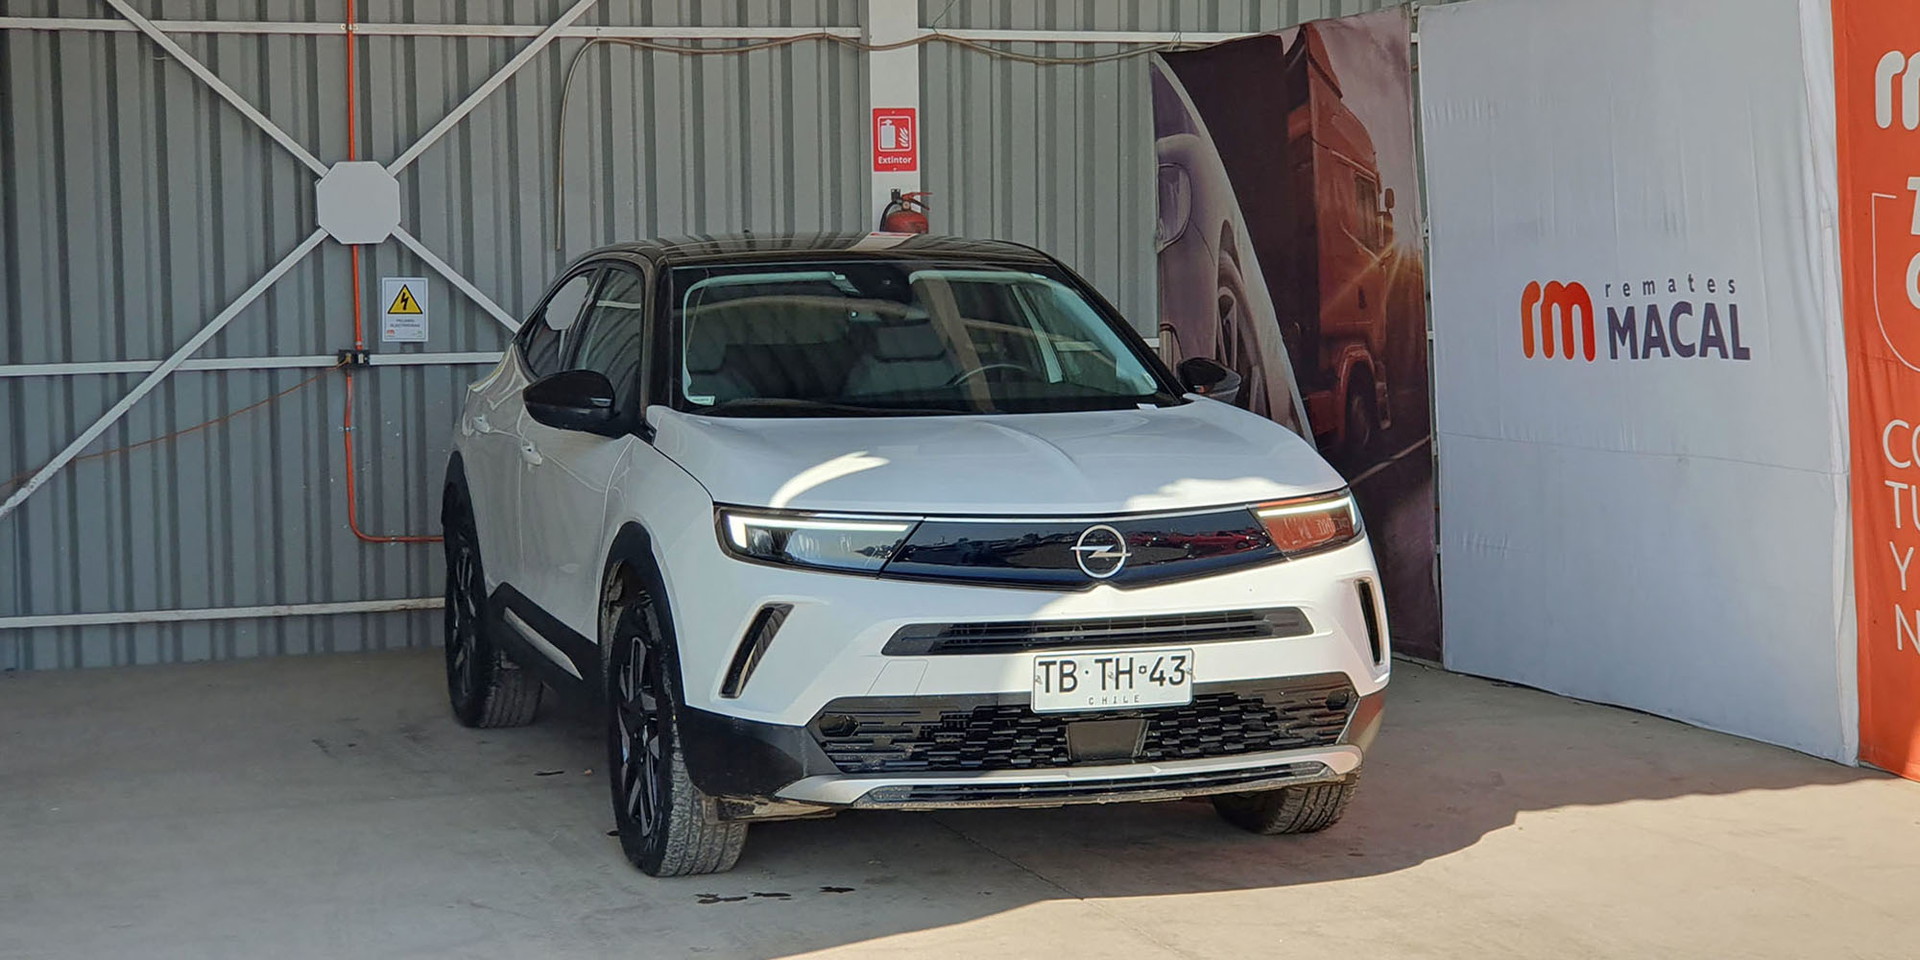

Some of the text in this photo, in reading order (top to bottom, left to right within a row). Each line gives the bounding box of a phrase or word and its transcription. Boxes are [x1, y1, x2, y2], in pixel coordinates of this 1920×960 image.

[878, 156, 912, 164] Extintor
[1605, 274, 1736, 298] remates
[1606, 301, 1751, 361] MACAL
[1889, 540, 1915, 592] Y
[1088, 694, 1141, 706] CHILE
